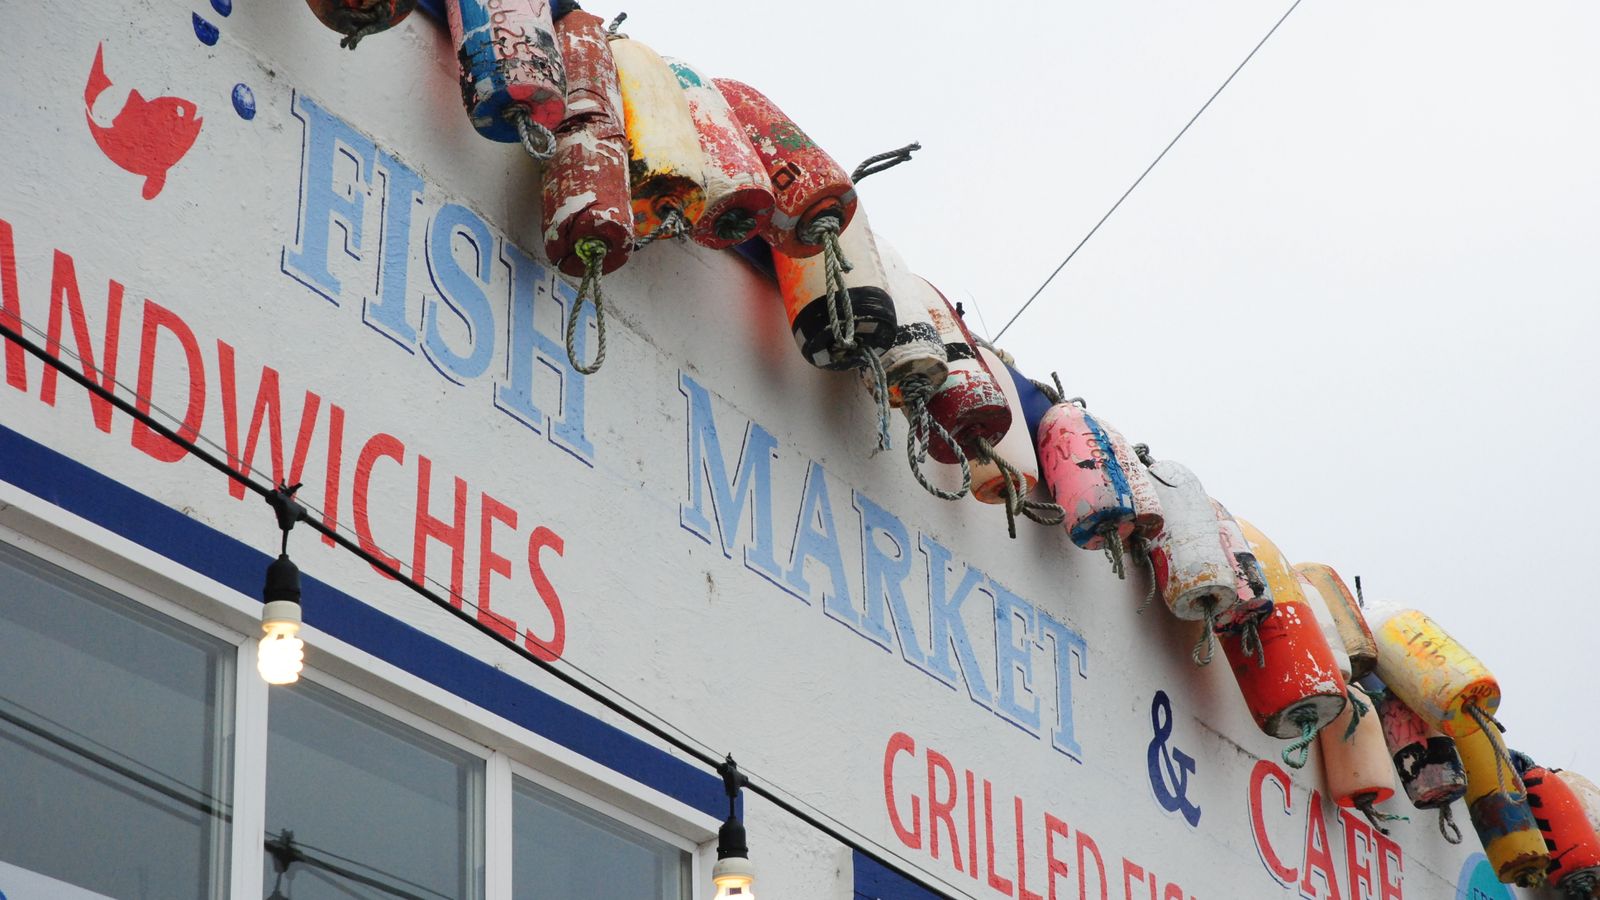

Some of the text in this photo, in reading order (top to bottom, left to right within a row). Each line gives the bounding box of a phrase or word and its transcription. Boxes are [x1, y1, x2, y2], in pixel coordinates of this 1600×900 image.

[281, 88, 1403, 900] FISH MARKET & CAFE
[884, 731, 1108, 900] GRILLED
